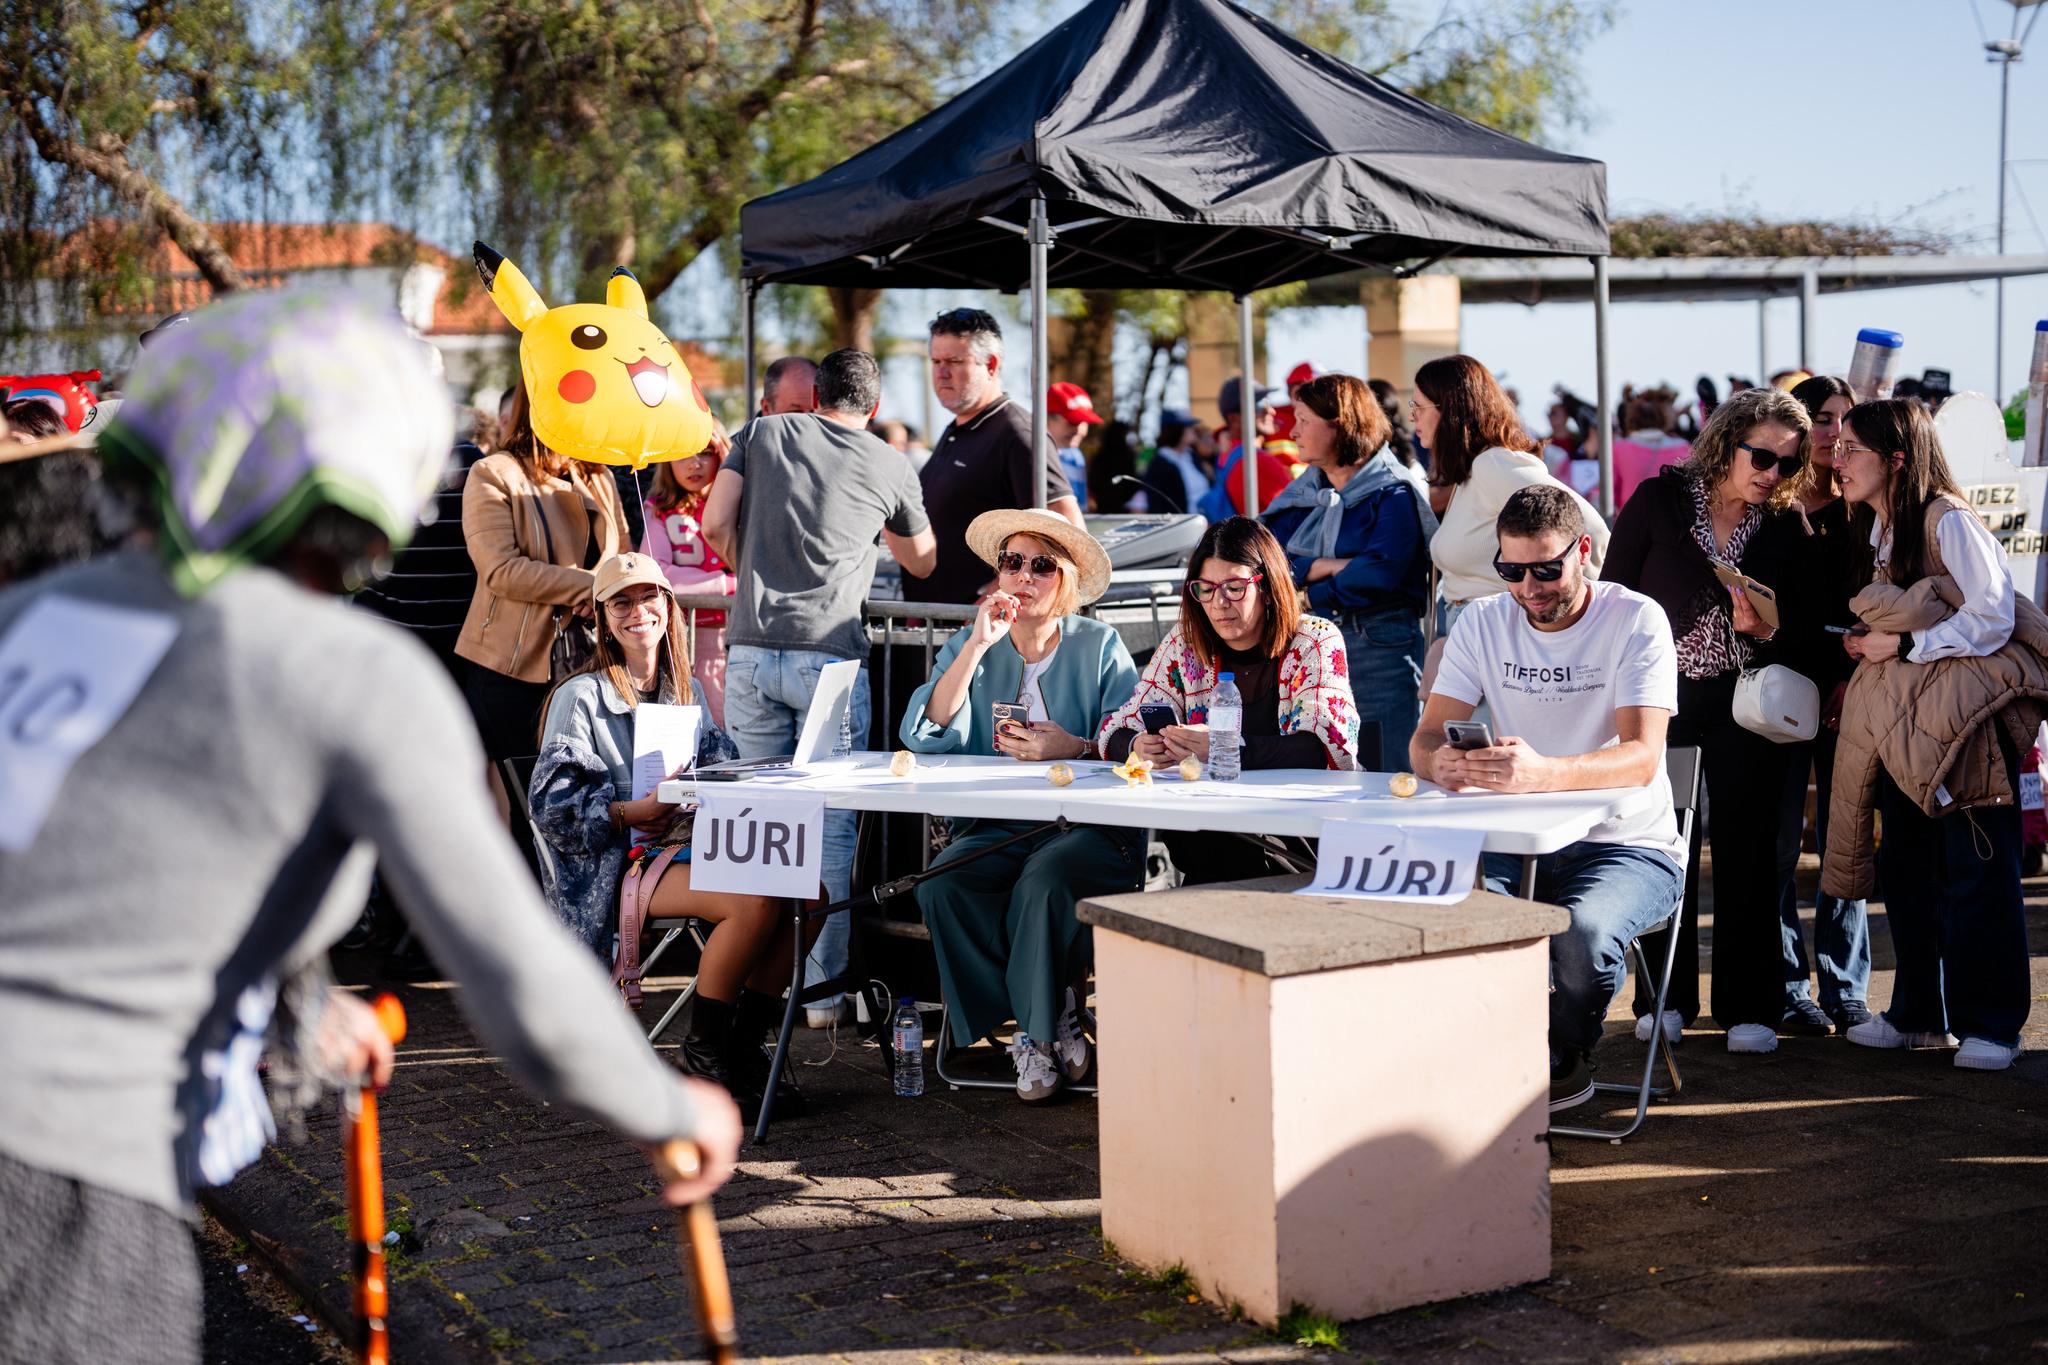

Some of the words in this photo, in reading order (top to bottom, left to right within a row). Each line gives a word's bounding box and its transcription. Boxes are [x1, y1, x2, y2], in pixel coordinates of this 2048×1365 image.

[1503, 662, 1571, 683] TIFFOSI
[703, 807, 806, 868] JÚRI
[1323, 844, 1456, 897] JÚRI
